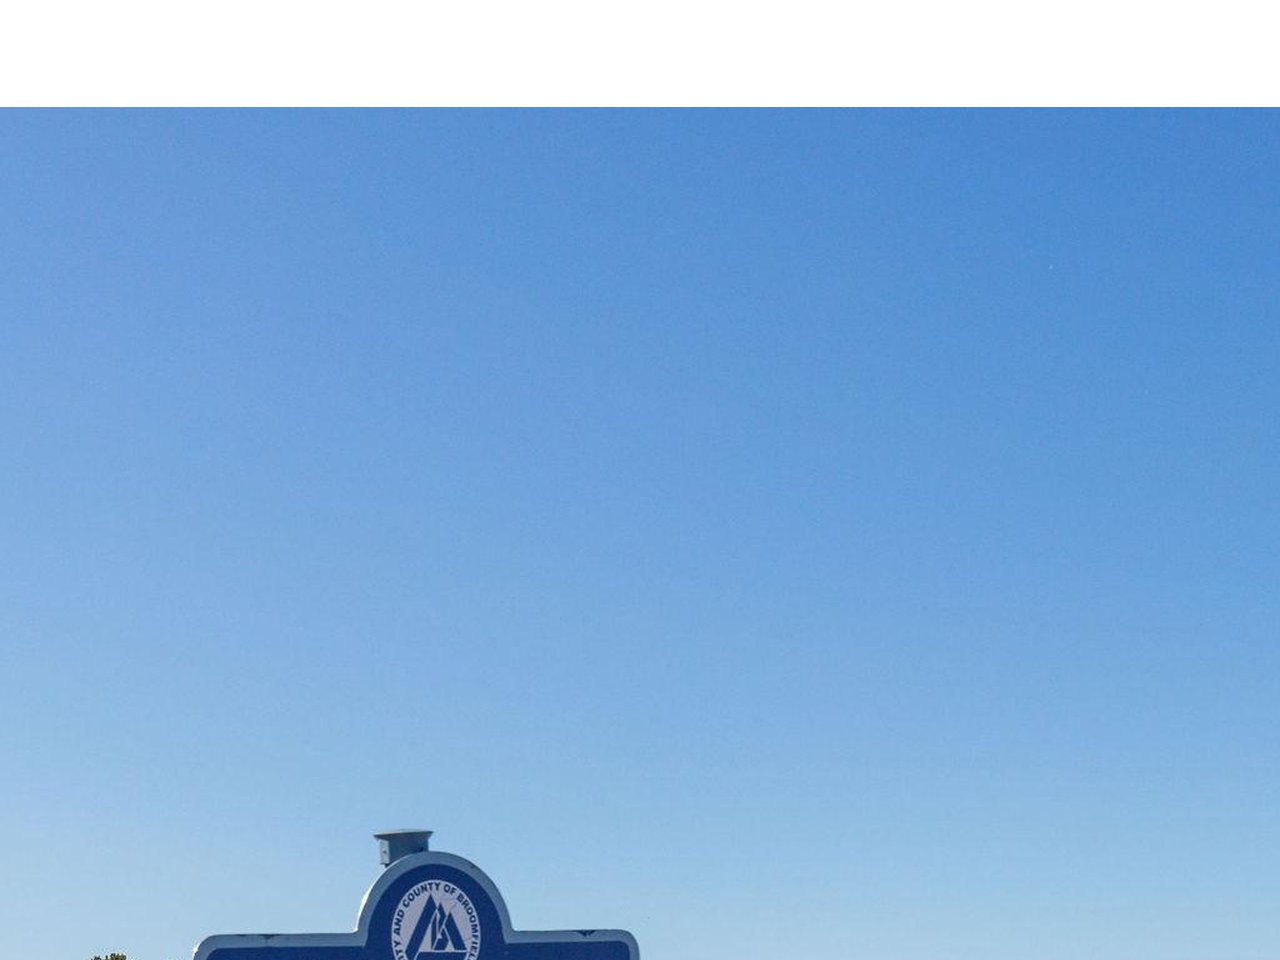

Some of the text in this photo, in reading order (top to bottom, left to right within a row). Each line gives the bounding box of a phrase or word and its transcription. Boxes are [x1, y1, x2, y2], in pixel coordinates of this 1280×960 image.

[394, 910, 404, 936] AND
[402, 883, 441, 907] COUNTY
[444, 884, 457, 895] OF
